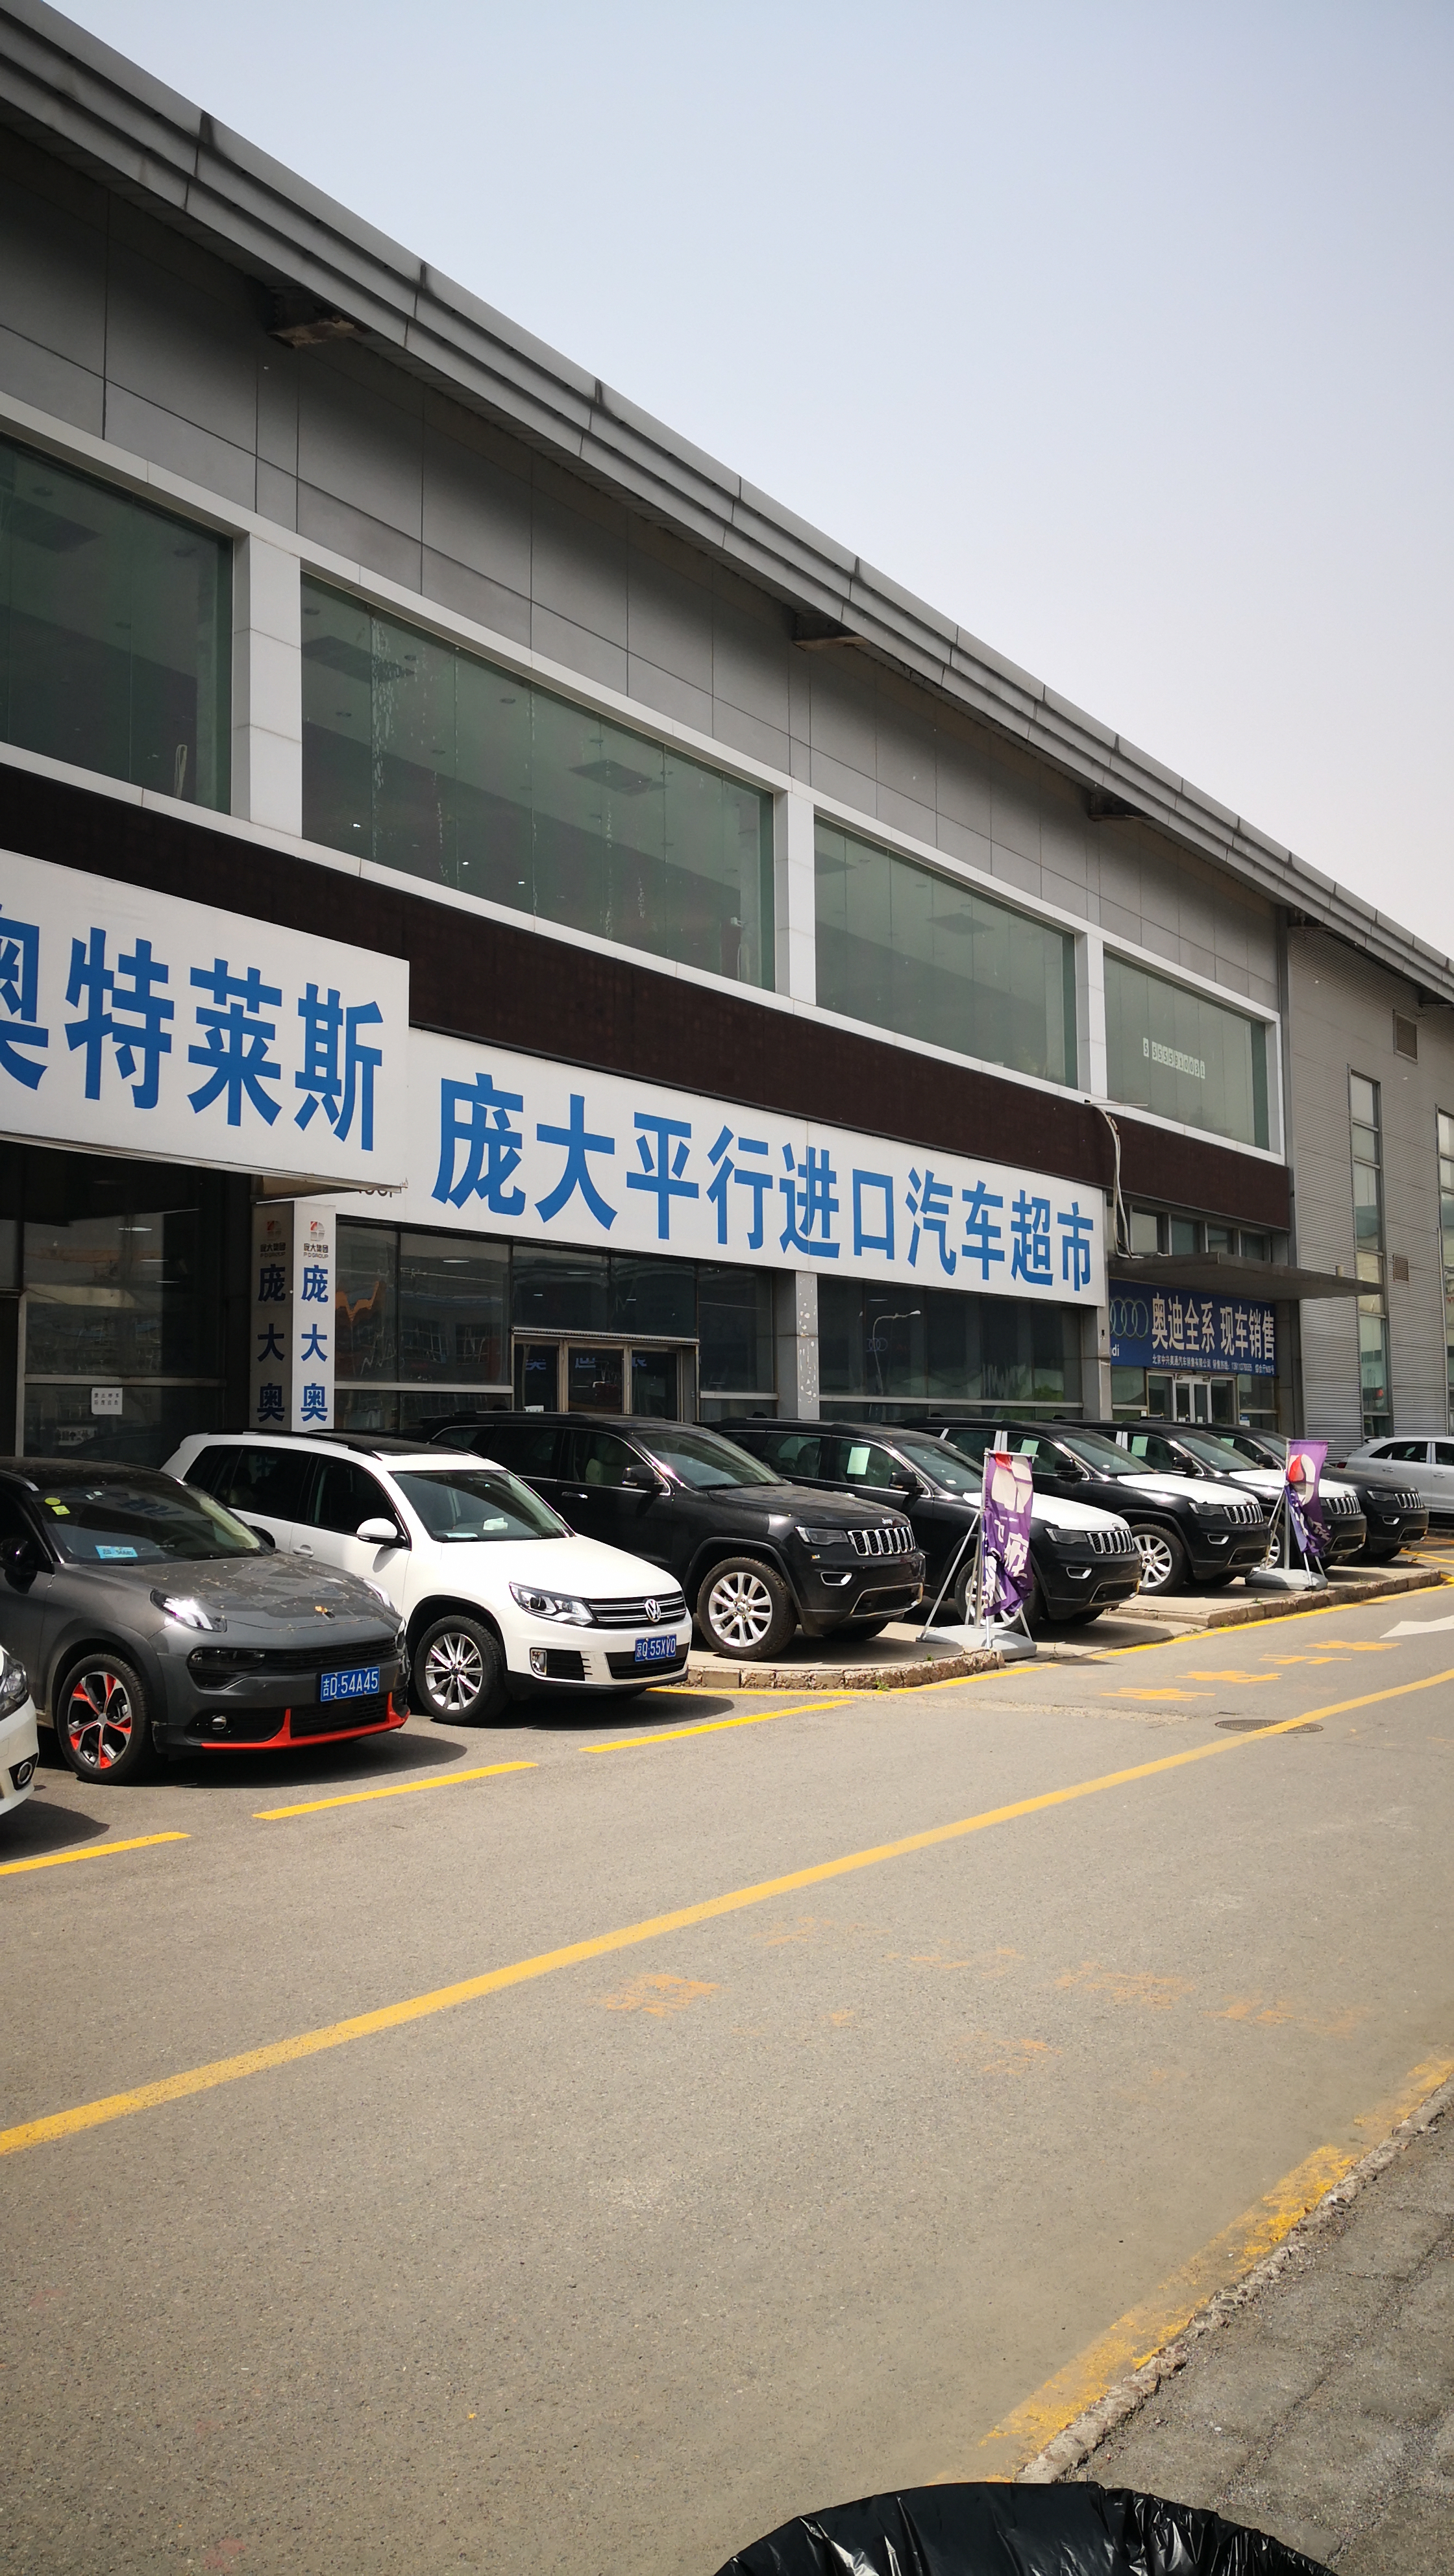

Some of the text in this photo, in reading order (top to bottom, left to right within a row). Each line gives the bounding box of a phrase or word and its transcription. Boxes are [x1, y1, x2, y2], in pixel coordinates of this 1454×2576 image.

[431, 1072, 1094, 1291] 庞大平行进口汽车超市
[1109, 1344, 1120, 1357] di
[1152, 1291, 1275, 1361] 奥迪全系 现车销售
